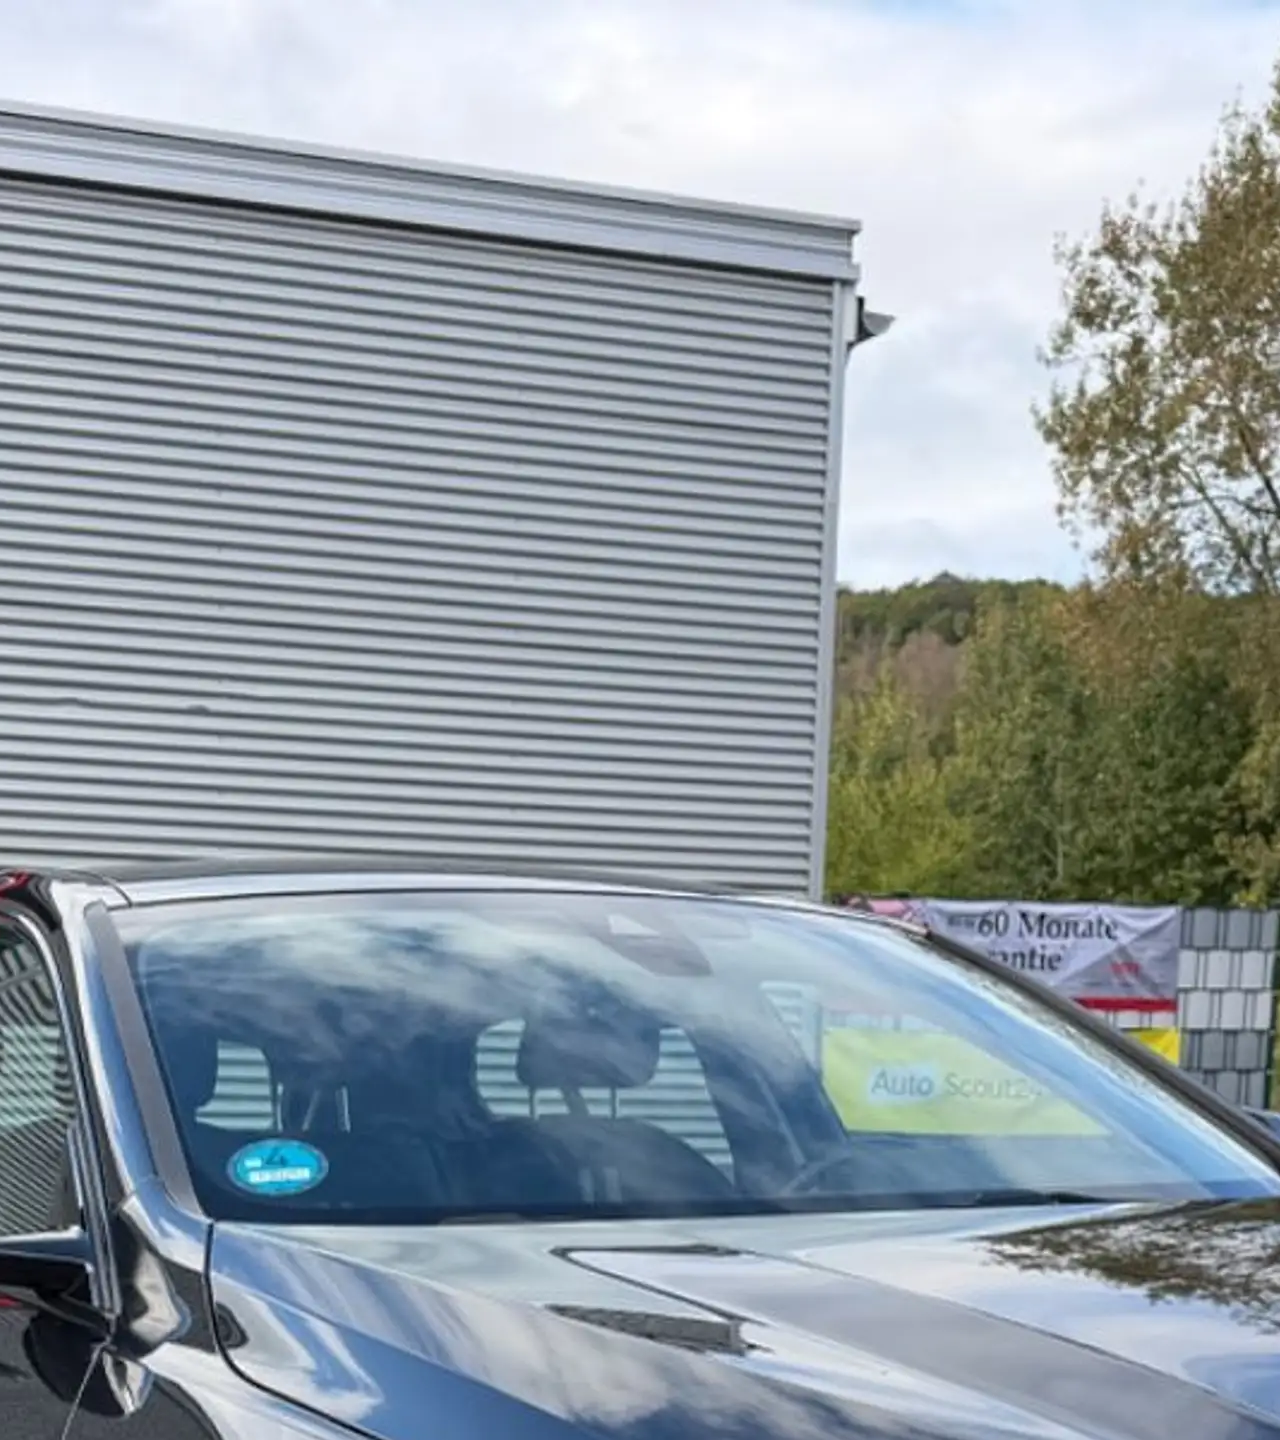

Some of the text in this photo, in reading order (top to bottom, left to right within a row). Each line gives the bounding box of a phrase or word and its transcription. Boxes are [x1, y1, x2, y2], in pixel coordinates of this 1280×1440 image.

[977, 909, 1010, 937] 60
[1019, 910, 1119, 941] Monate
[871, 1068, 934, 1097] Auto
